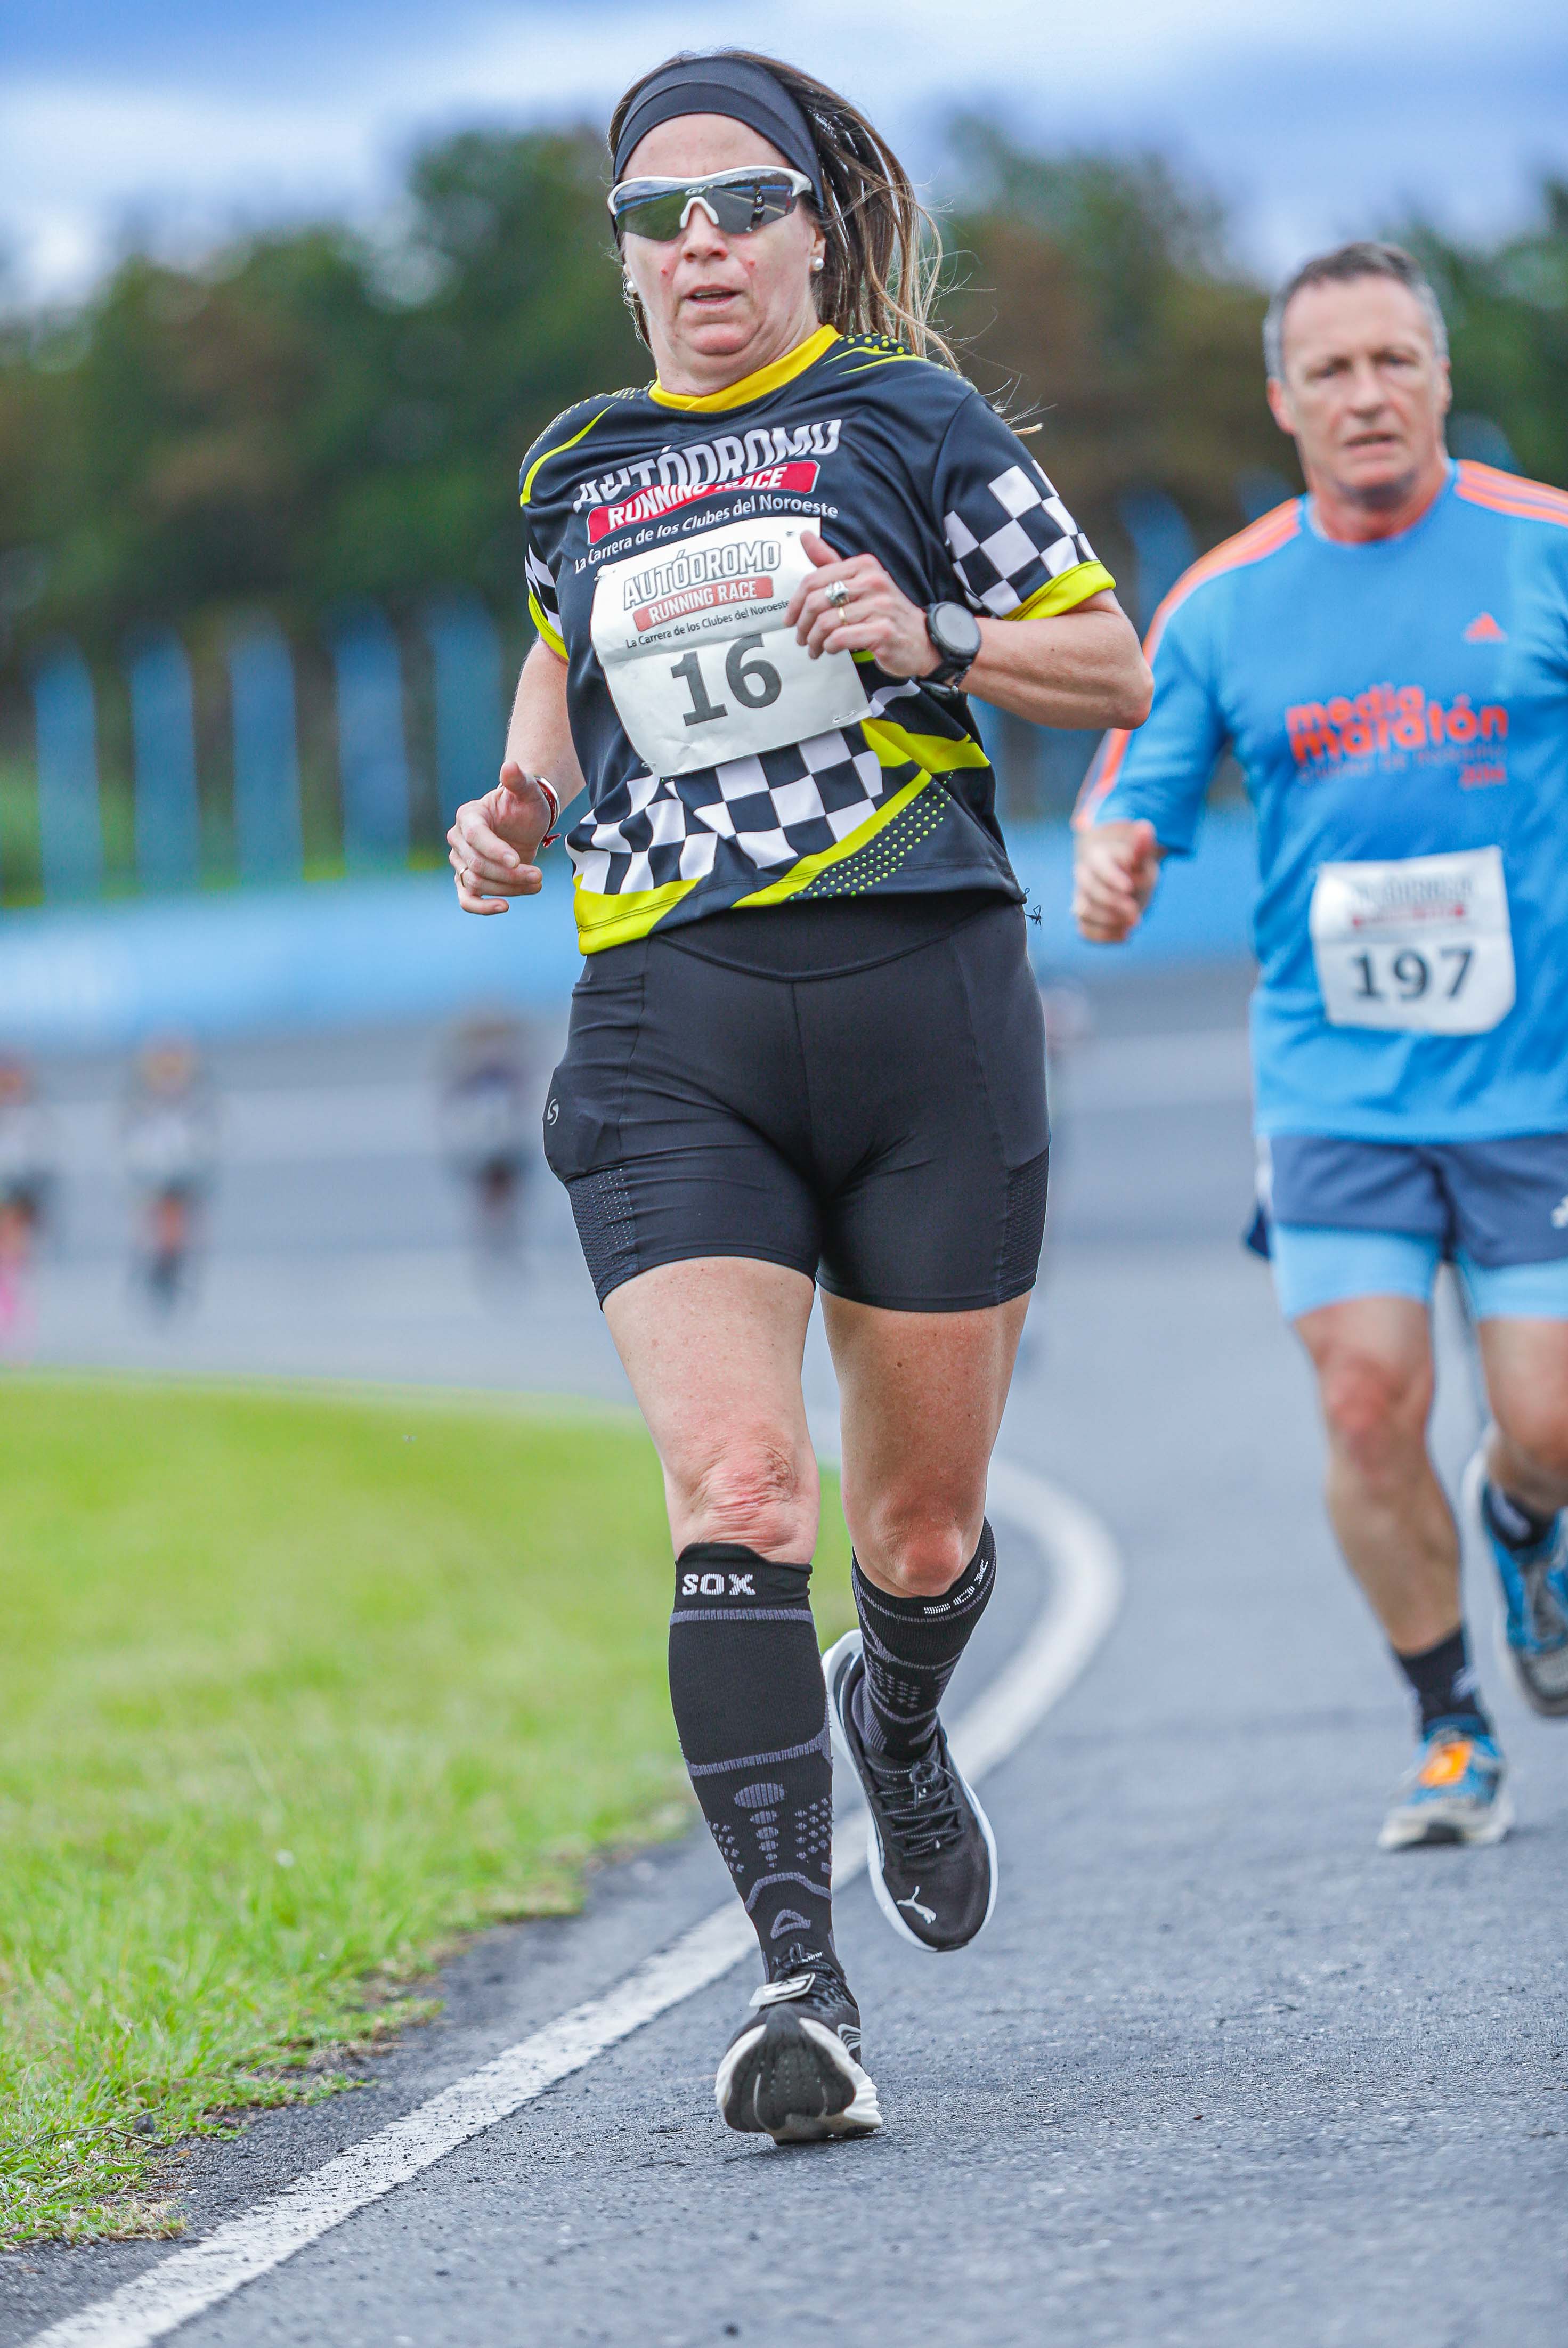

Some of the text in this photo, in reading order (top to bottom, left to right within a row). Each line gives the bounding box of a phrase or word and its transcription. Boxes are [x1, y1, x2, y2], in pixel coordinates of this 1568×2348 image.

[575, 494, 839, 575] La Carrera de los Clubes del Noroeste
[623, 540, 781, 611] AUTÓDROMO
[648, 580, 758, 624] RUNNING RACE
[625, 600, 790, 649] La Carrera de los Clubes del Noroeste
[670, 633, 782, 727] 16
[1351, 944, 1475, 1002] 197
[681, 1573, 757, 1596] SOX
